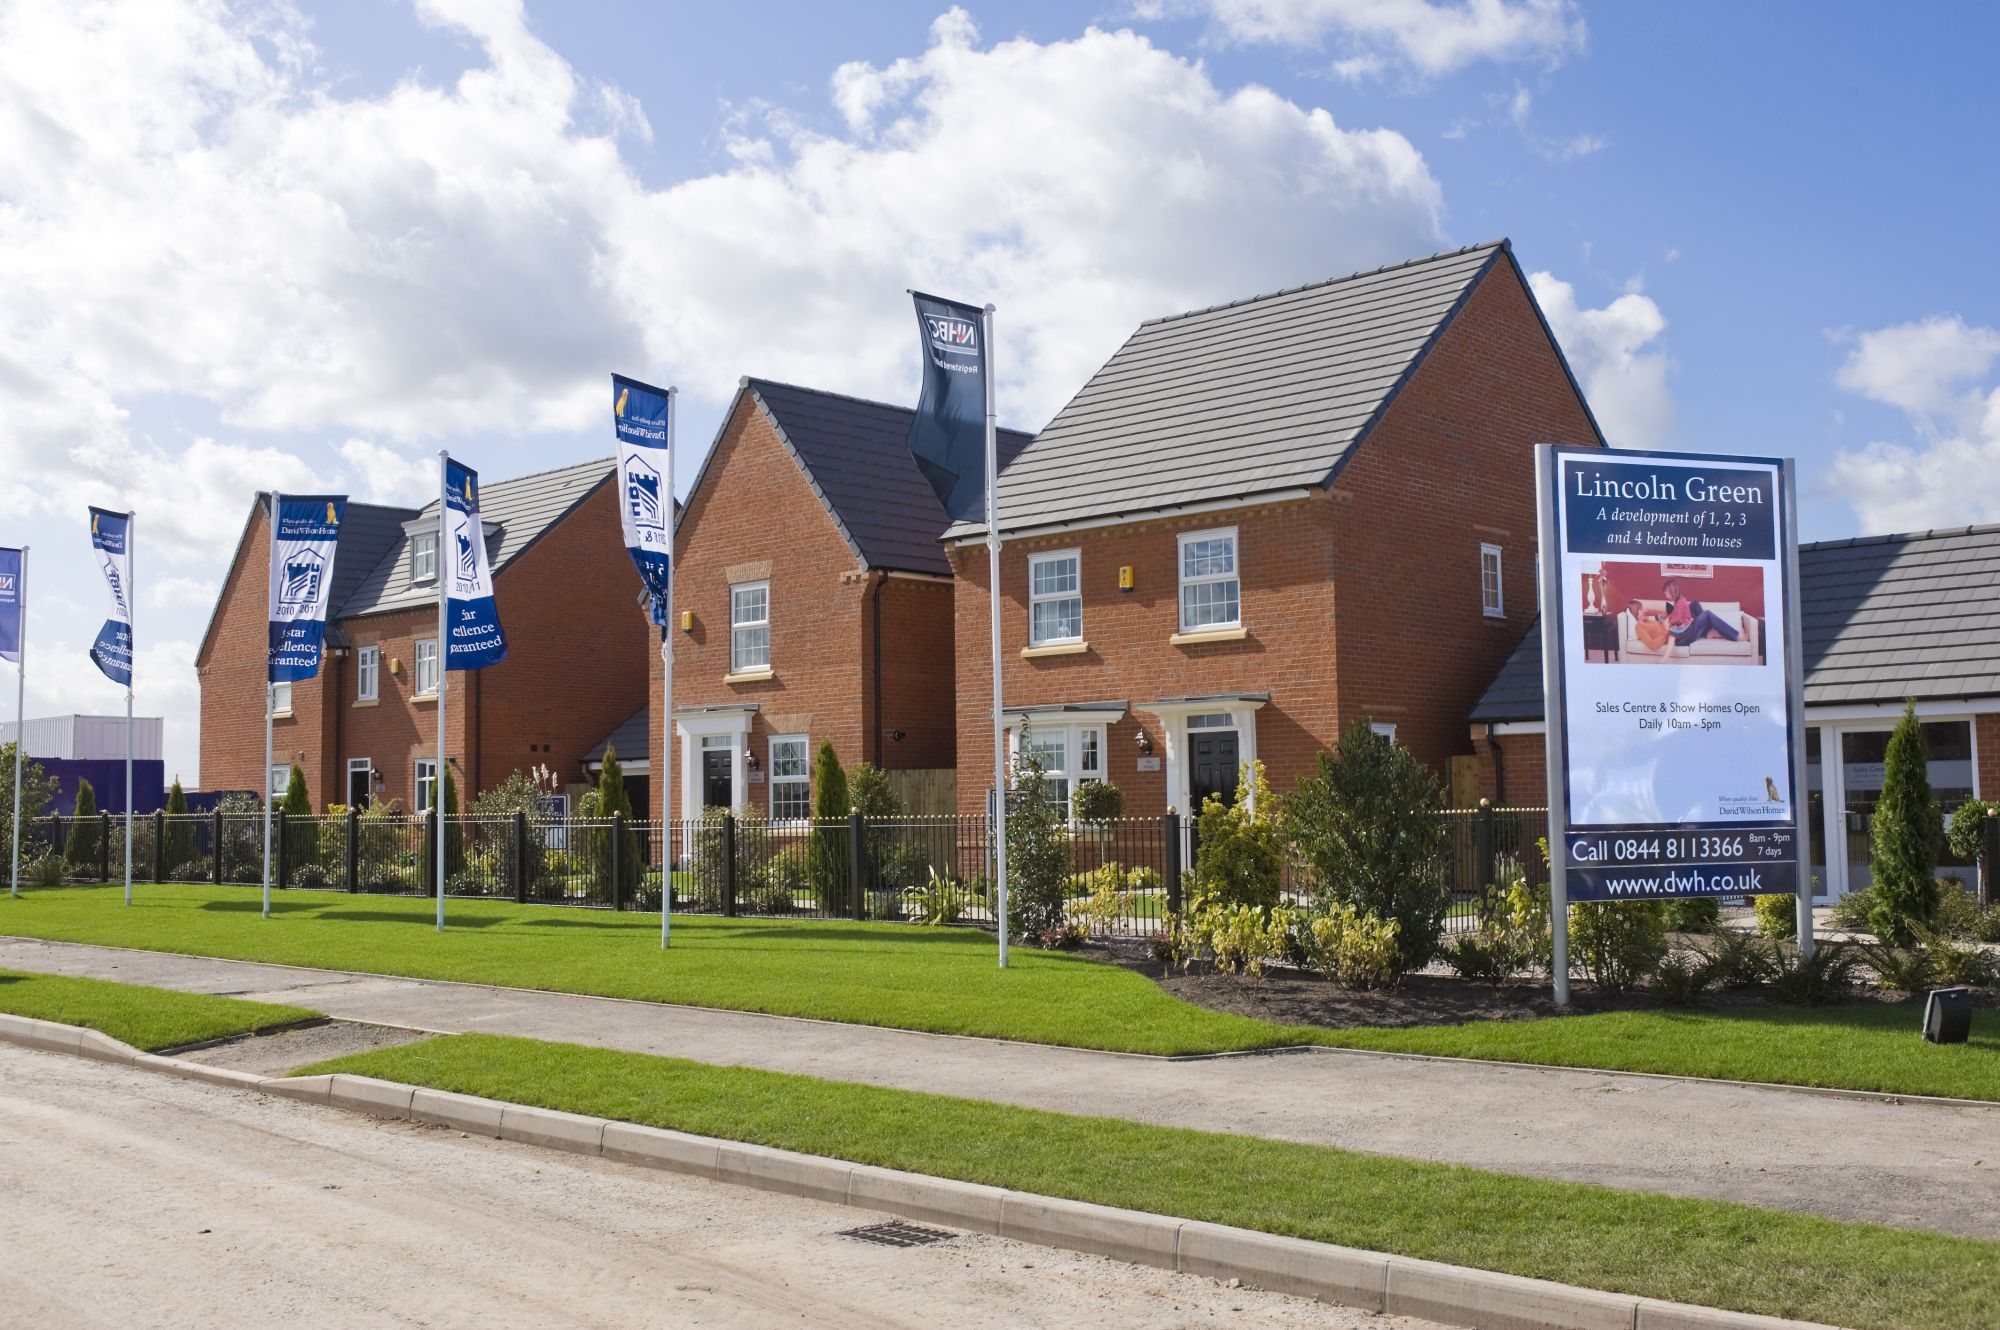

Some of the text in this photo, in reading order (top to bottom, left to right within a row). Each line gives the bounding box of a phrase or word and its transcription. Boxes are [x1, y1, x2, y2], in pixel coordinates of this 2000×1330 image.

[1575, 471, 1763, 504] Lincoln Green
[1596, 507, 1747, 528] A development of 1, 2, 3
[1607, 530, 1742, 548] and 4 bedroom houses
[276, 604, 318, 616] 2010 201
[1596, 702, 1760, 716] Sales Centre & Show Homes Open
[1639, 718, 1663, 731] Daily
[1666, 718, 1692, 730] 10am
[1700, 718, 1721, 732] 5pm
[1720, 806, 1786, 814] David Wilson Homes
[1749, 833, 1766, 843] 8am
[1774, 834, 1790, 844] 9pm
[1572, 836, 1743, 862] Call 0844 8113366
[1758, 846, 1782, 858] 7 days
[1606, 867, 1762, 895] www.dwh.co.uk
